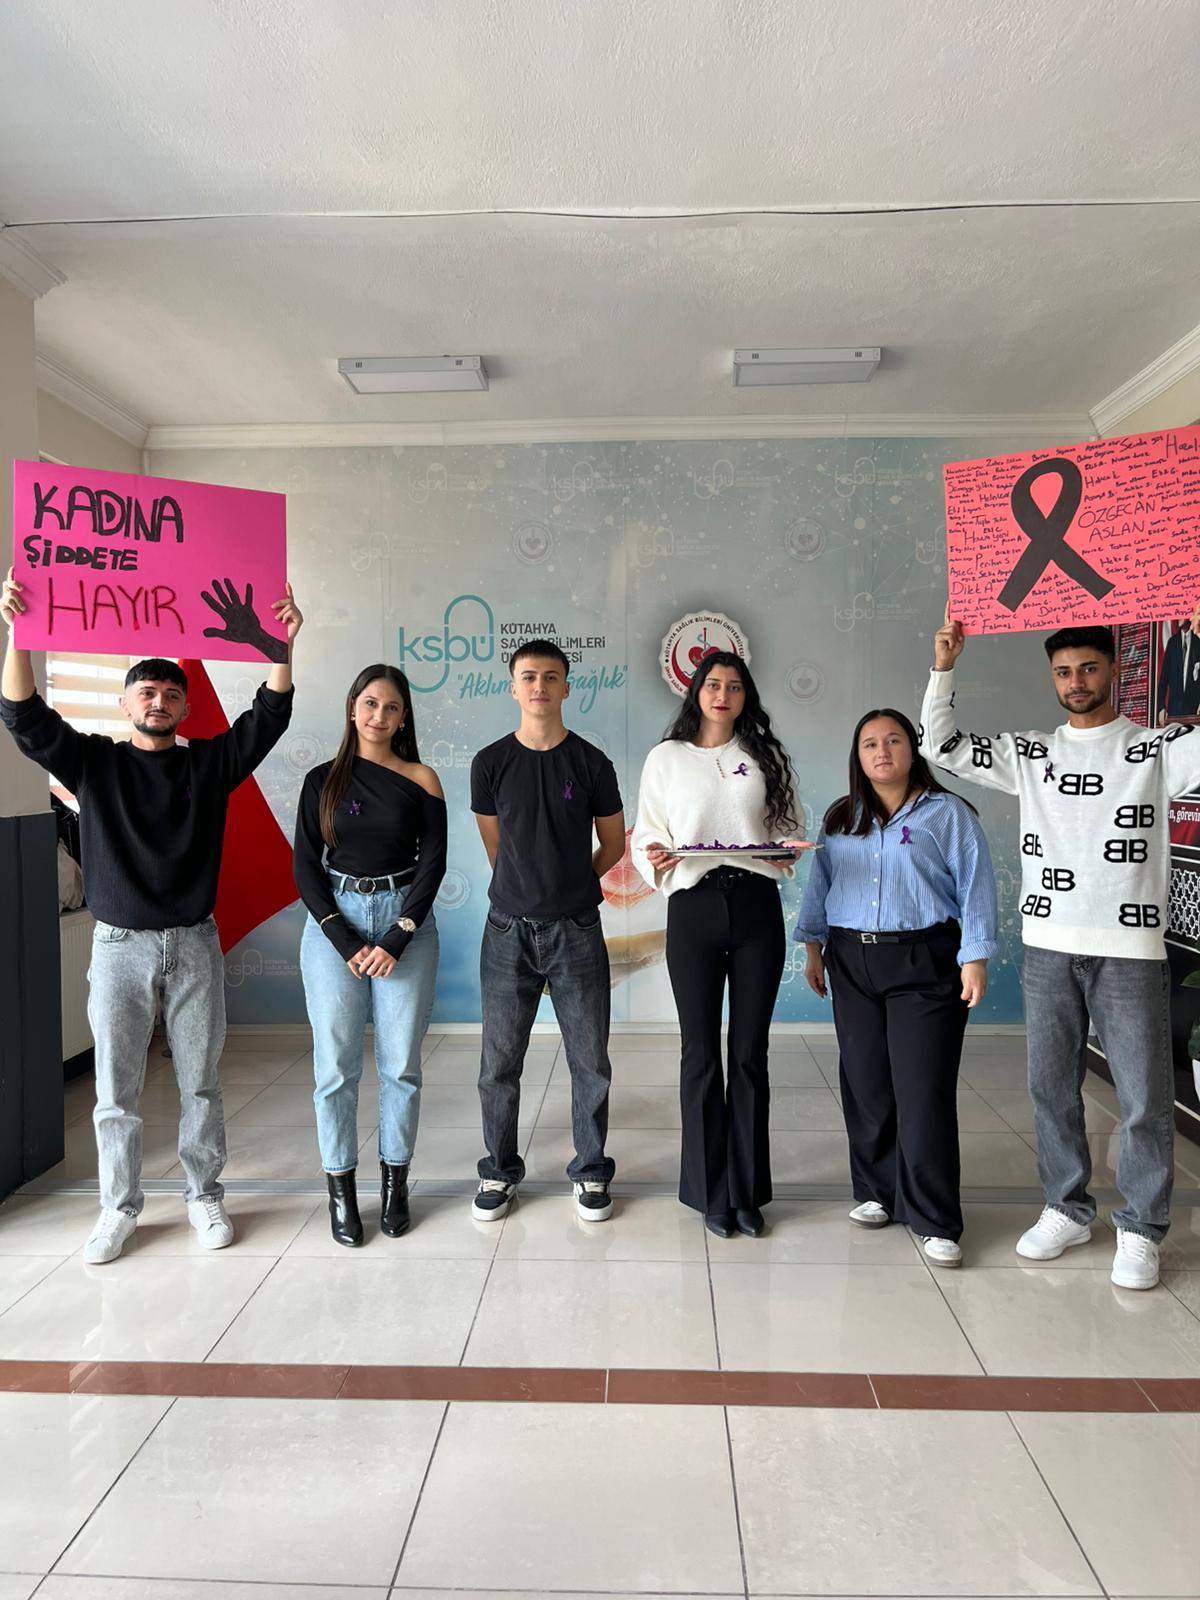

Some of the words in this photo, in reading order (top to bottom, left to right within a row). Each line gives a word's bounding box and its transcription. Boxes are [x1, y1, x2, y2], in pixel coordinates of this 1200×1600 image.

[34, 482, 184, 543] KADINA
[1078, 499, 1155, 529] ÖZGECAN
[1089, 520, 1145, 542] ASLAN
[48, 577, 185, 635] HAYIR
[501, 622, 557, 634] KÜTAHYA
